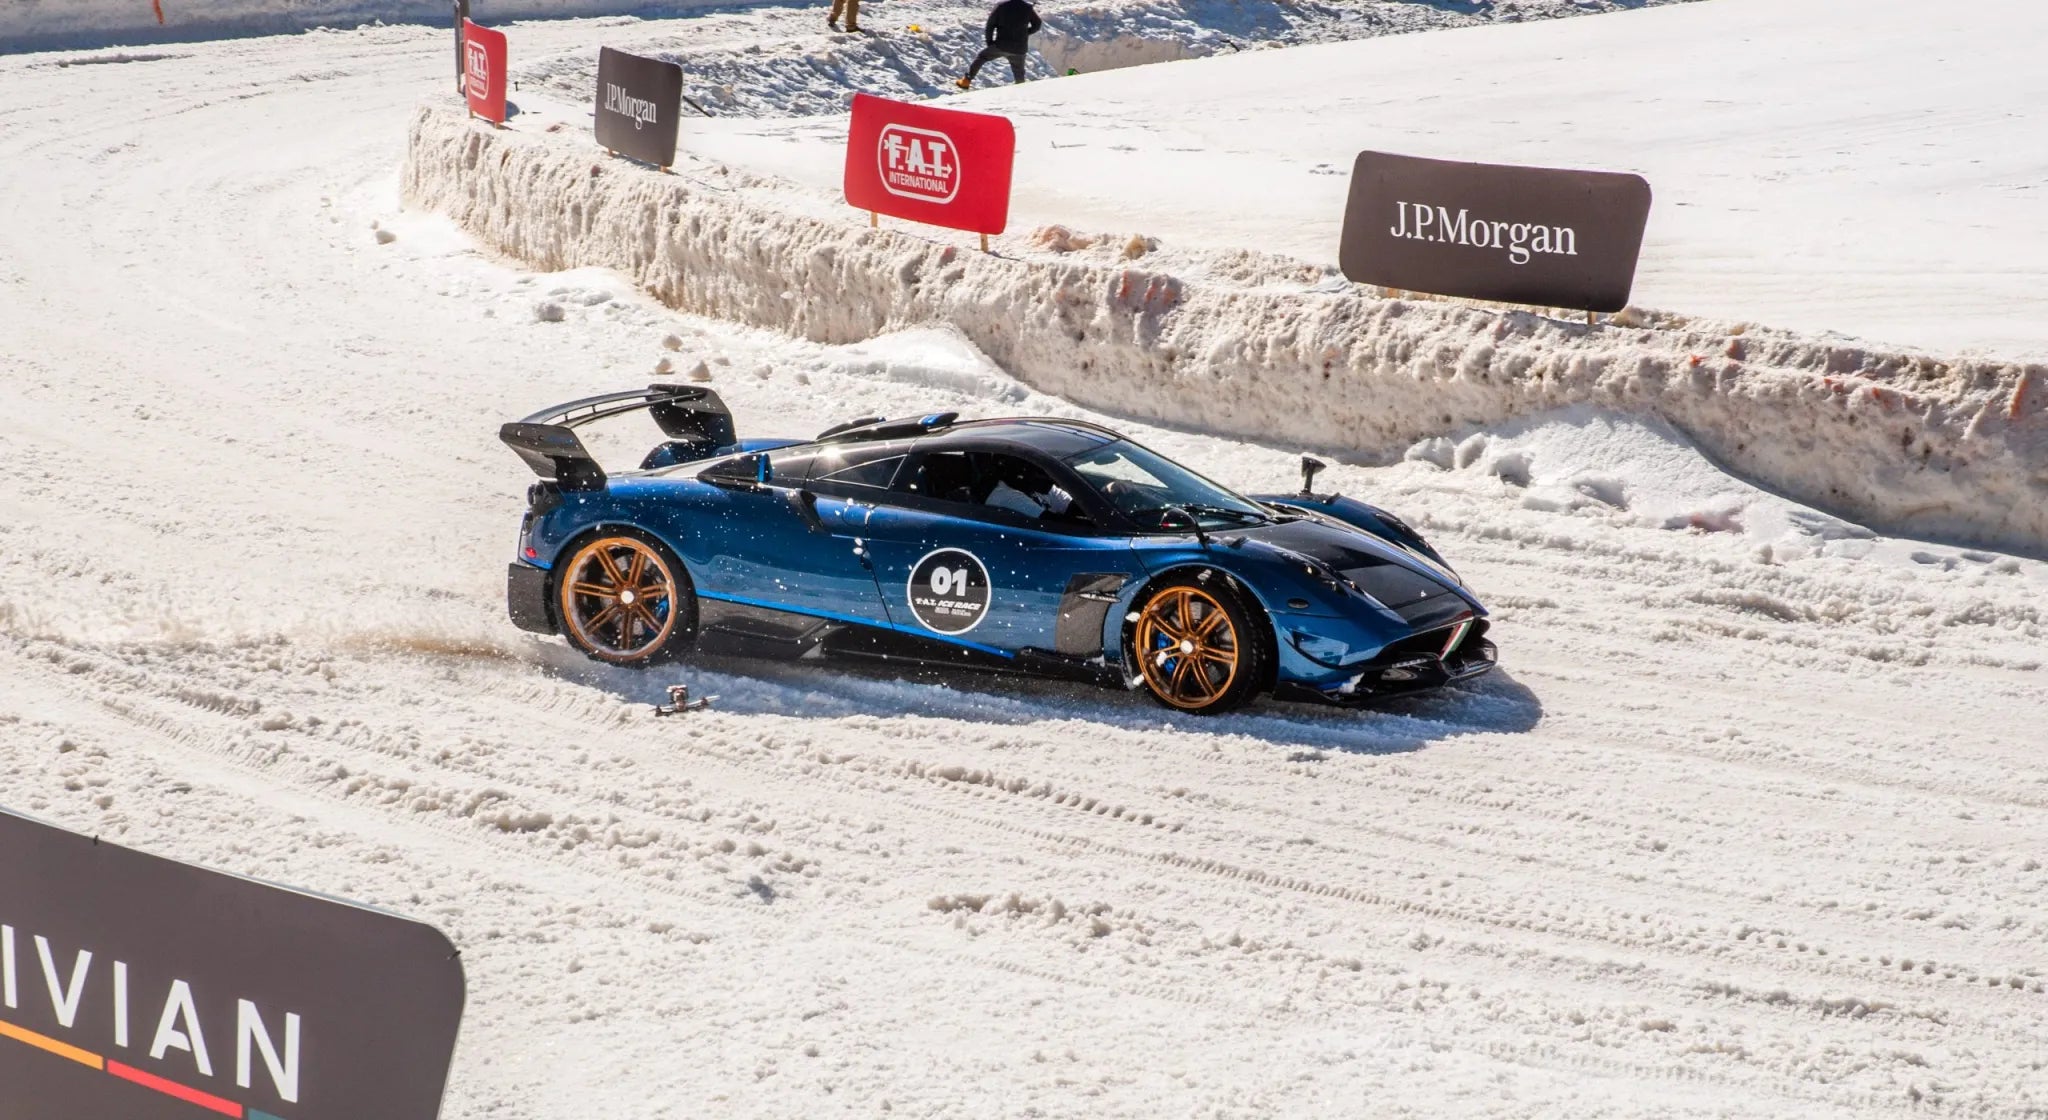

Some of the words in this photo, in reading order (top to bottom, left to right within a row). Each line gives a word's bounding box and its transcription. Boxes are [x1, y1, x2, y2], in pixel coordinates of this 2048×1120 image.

[889, 170, 948, 194] INTERNATIONAL
[1390, 201, 1578, 265] J.P.Morgan
[930, 566, 968, 597] 01
[937, 600, 956, 608] ICE
[954, 601, 982, 611] RACE
